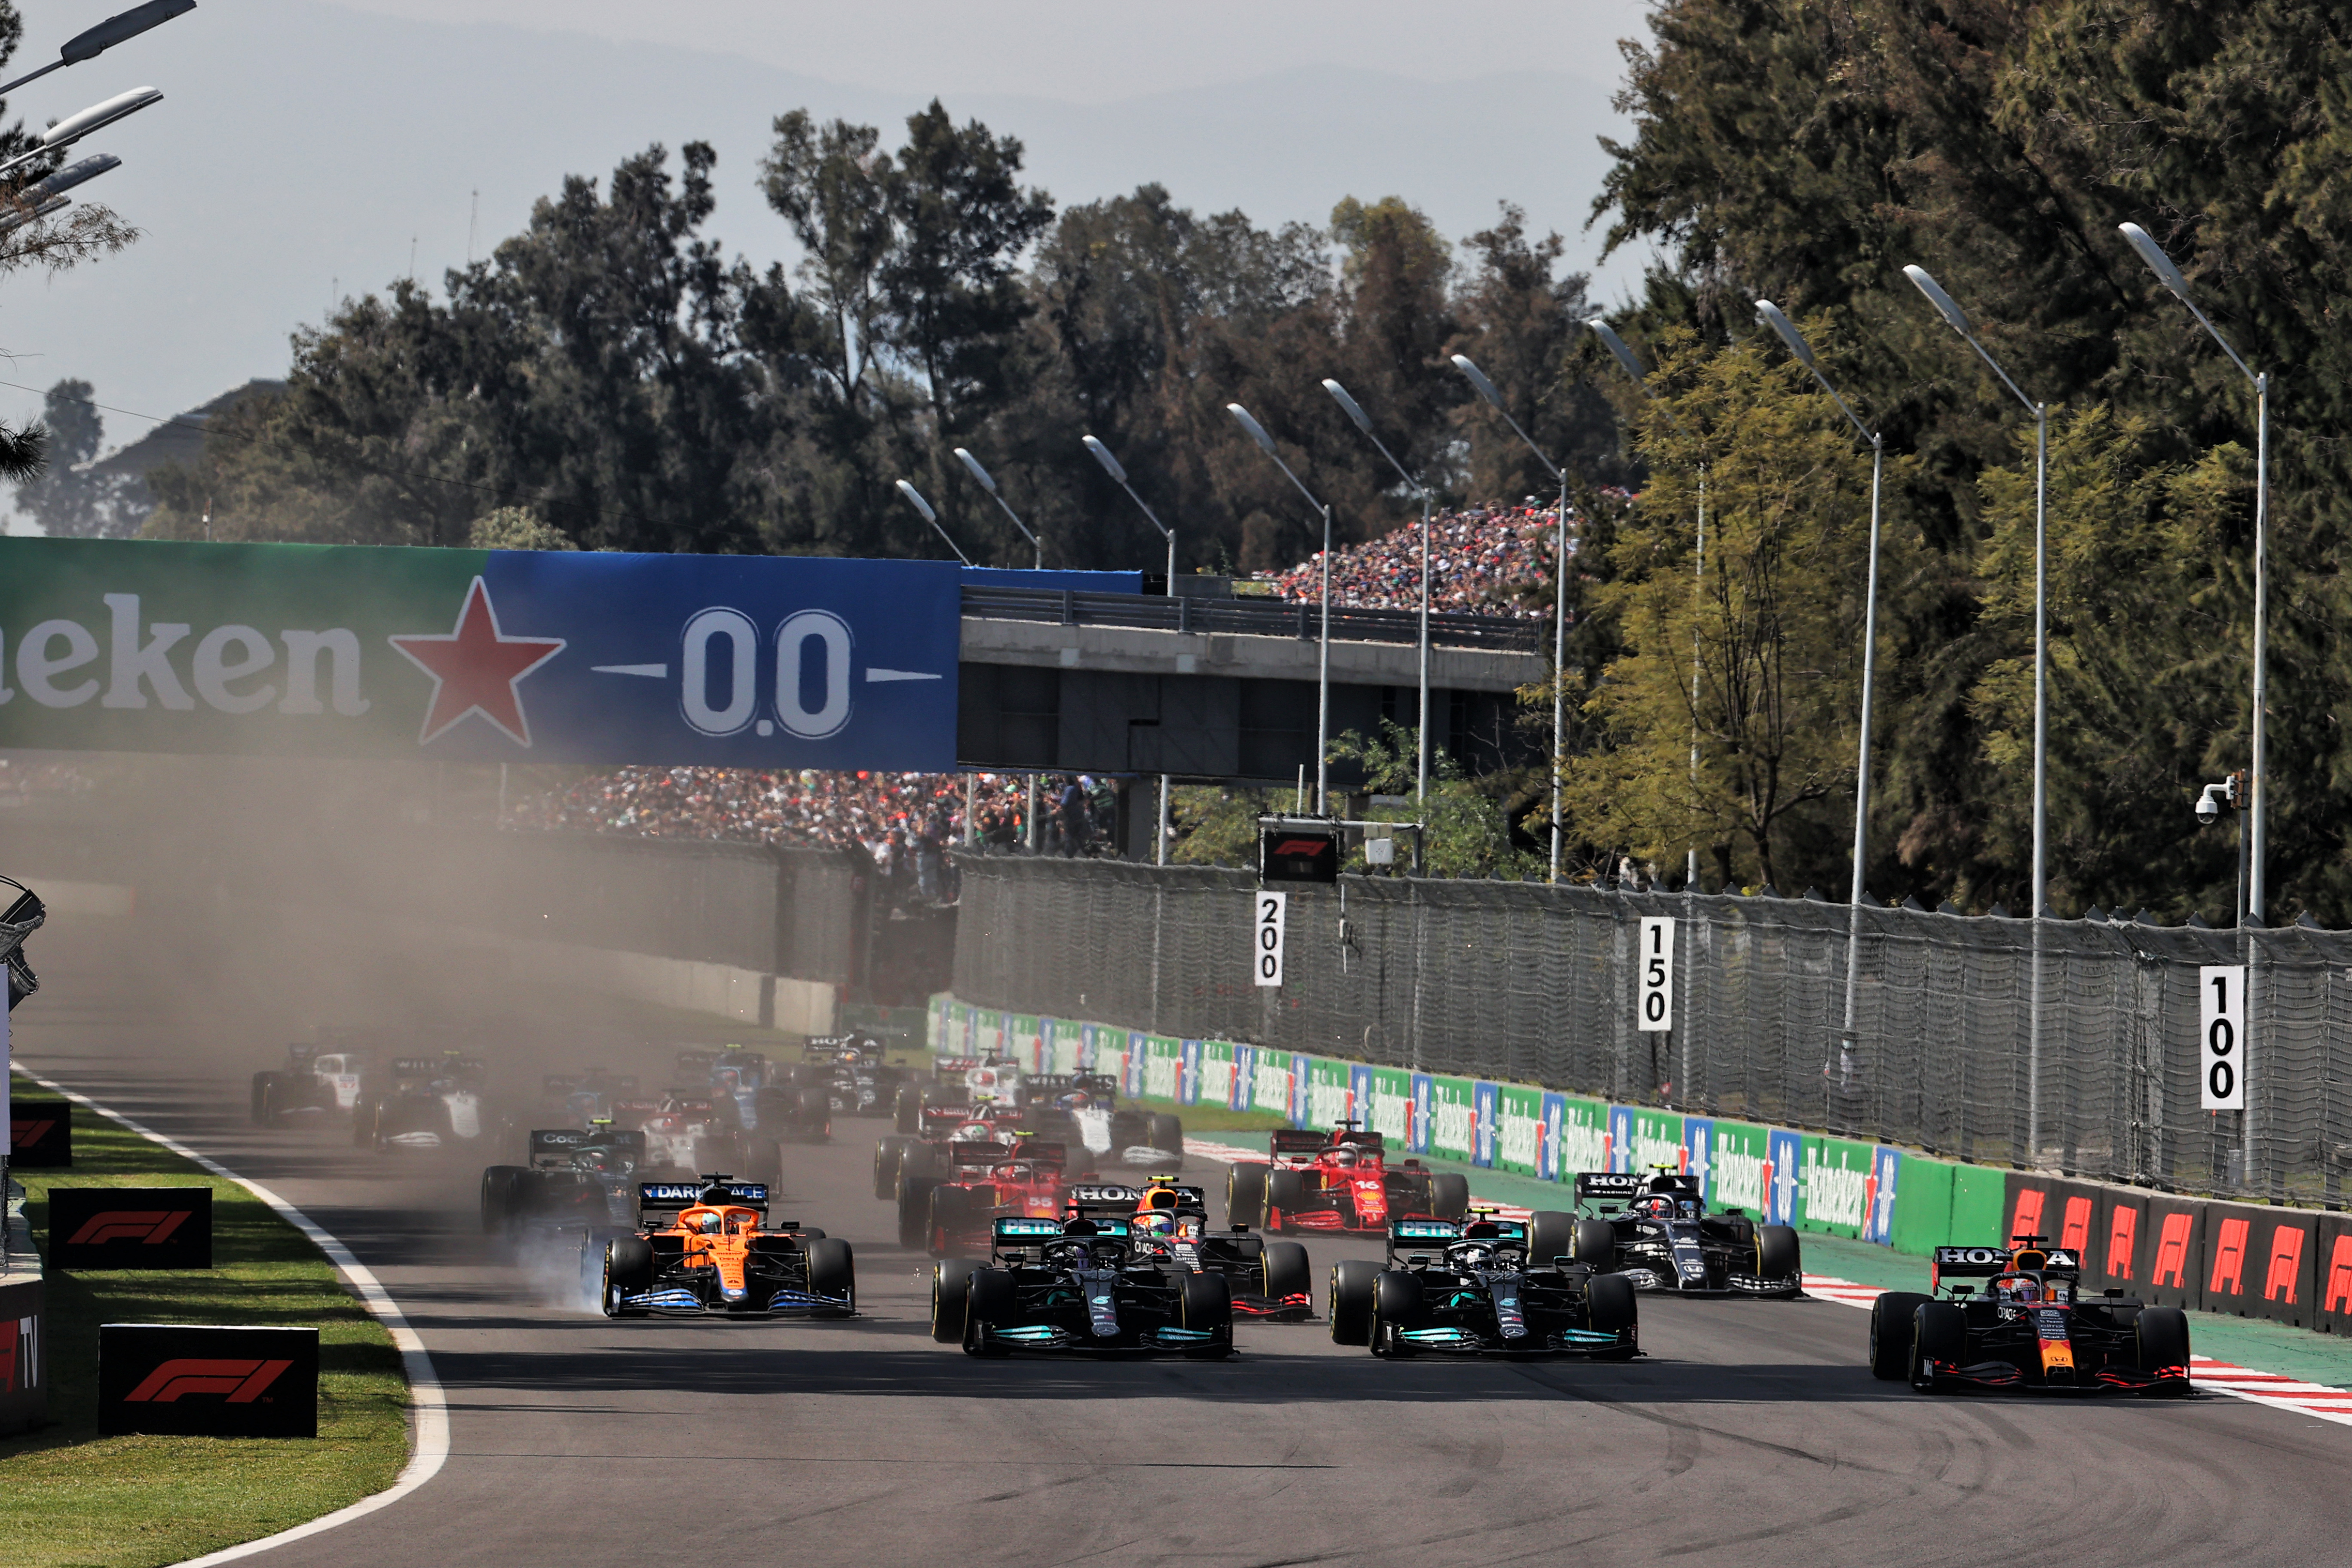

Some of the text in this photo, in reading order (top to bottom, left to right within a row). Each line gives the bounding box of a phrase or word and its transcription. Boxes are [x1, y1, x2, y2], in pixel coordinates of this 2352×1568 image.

[0, 593, 370, 716] eken
[1273, 839, 1328, 856] F1
[1261, 899, 1278, 978] 200
[1646, 925, 1665, 1022] 150
[2209, 977, 2234, 1099] 100
[1029, 1197, 1053, 1207] 55
[1355, 1180, 1380, 1190] 16
[1716, 1133, 1761, 1211] Heineken
[1806, 1146, 1864, 1227] Heineken
[67, 1211, 193, 1244] F1
[2107, 1205, 2138, 1280] F1
[2152, 1213, 2193, 1288] F1
[2210, 1218, 2250, 1295] F1
[2264, 1225, 2305, 1305] F1
[20, 1314, 37, 1388] TV
[123, 1359, 294, 1403] F1
